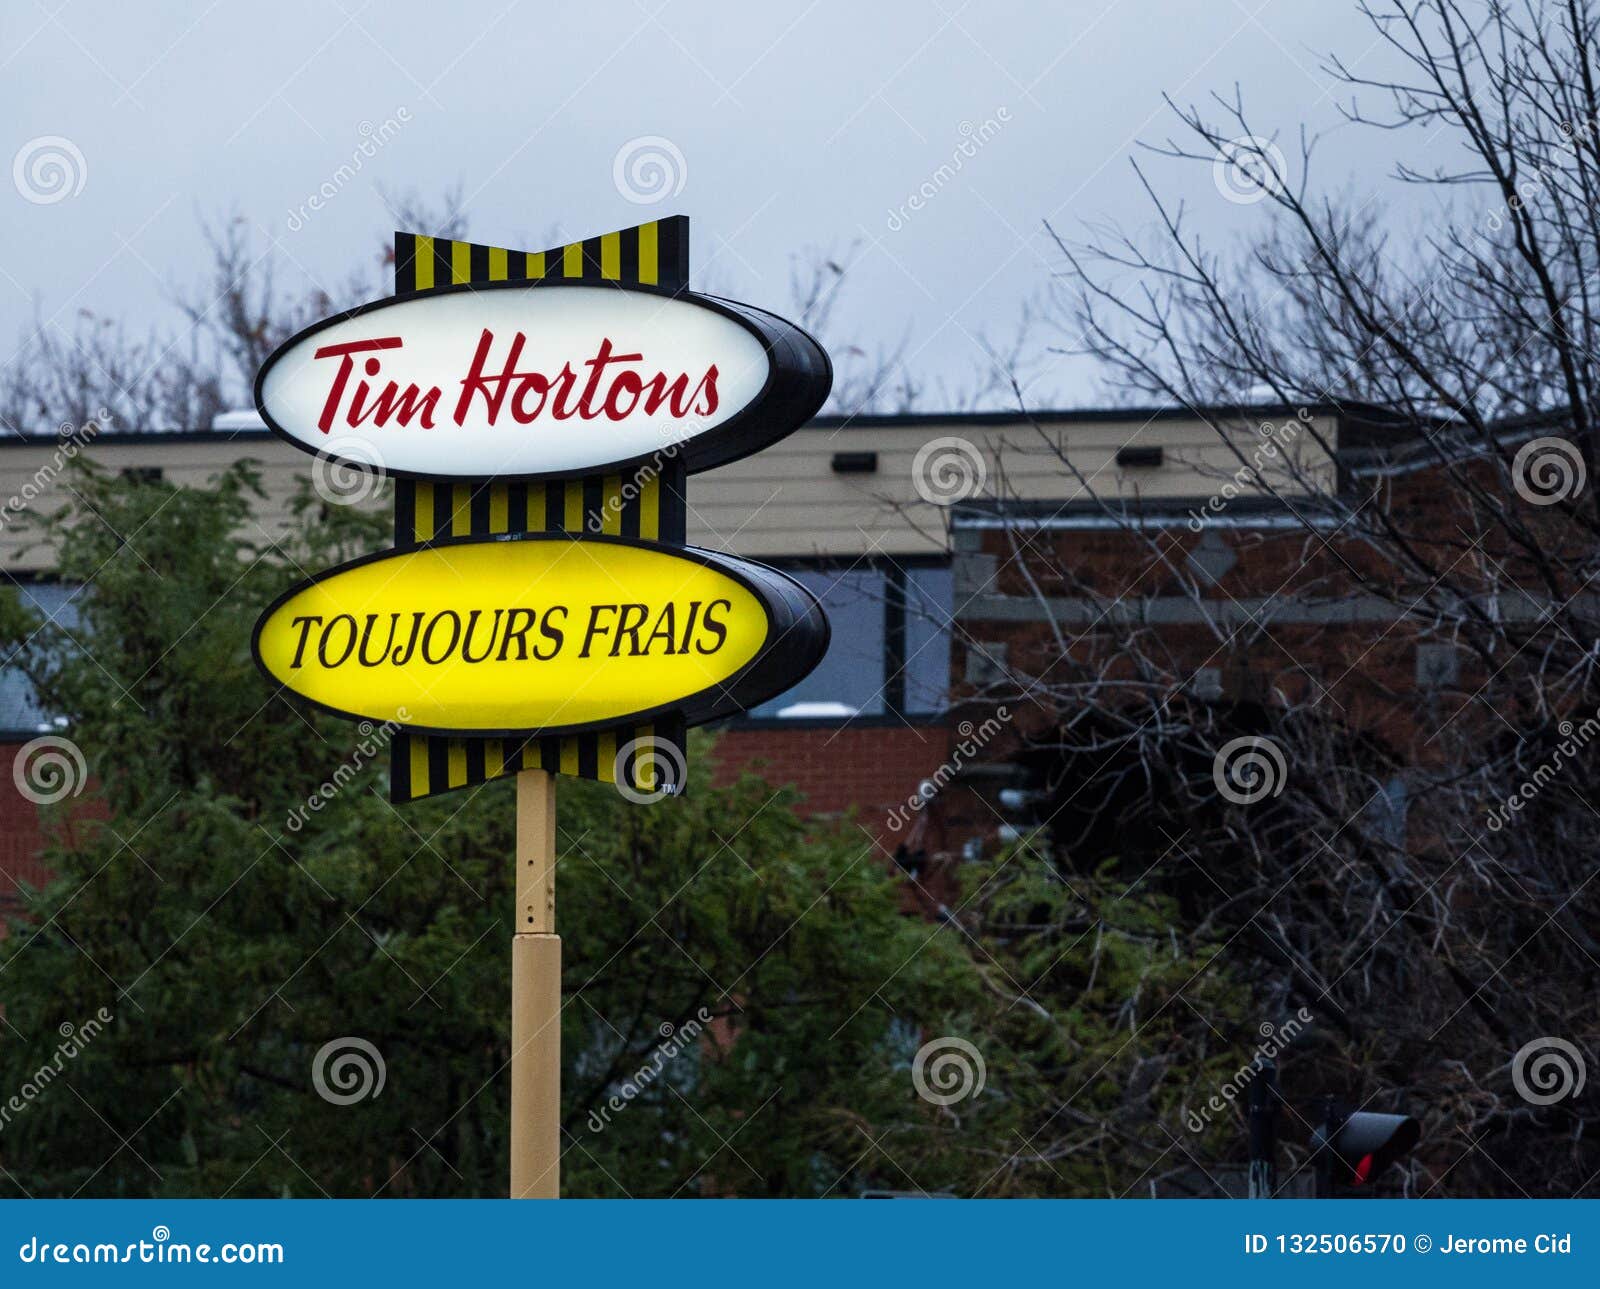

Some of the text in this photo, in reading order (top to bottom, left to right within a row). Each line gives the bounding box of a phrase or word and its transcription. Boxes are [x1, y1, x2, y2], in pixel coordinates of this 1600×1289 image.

[314, 328, 720, 434] Tim Hortons
[289, 599, 731, 669] TOUJOURS FRAIS
